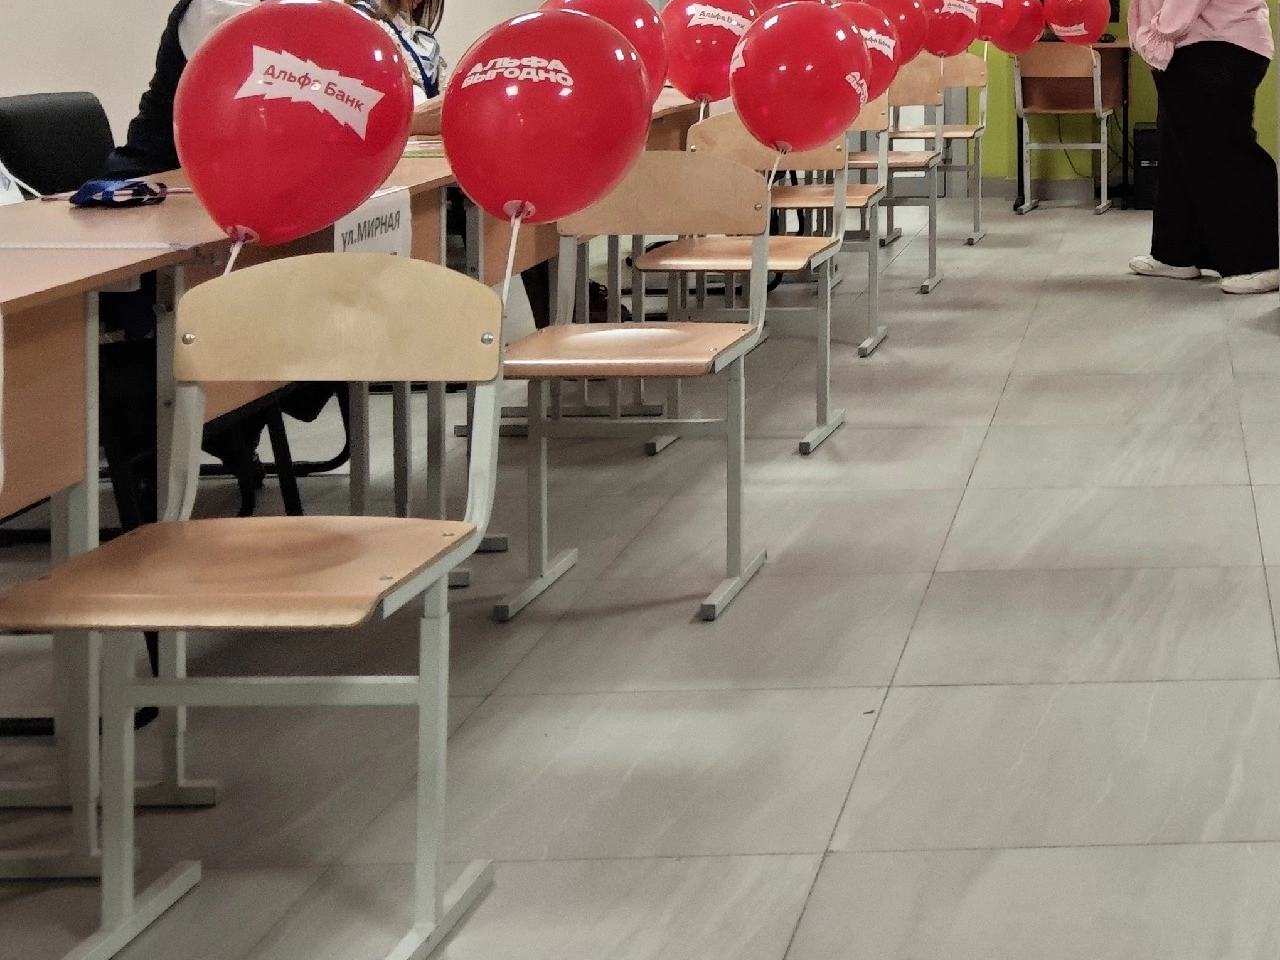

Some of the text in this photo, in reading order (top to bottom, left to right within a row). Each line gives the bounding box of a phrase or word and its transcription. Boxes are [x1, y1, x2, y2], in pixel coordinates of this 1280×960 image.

[465, 56, 570, 77] АЛЬФА
[323, 81, 365, 113] Банк
[341, 209, 401, 253] ул.МИРНАЯ
